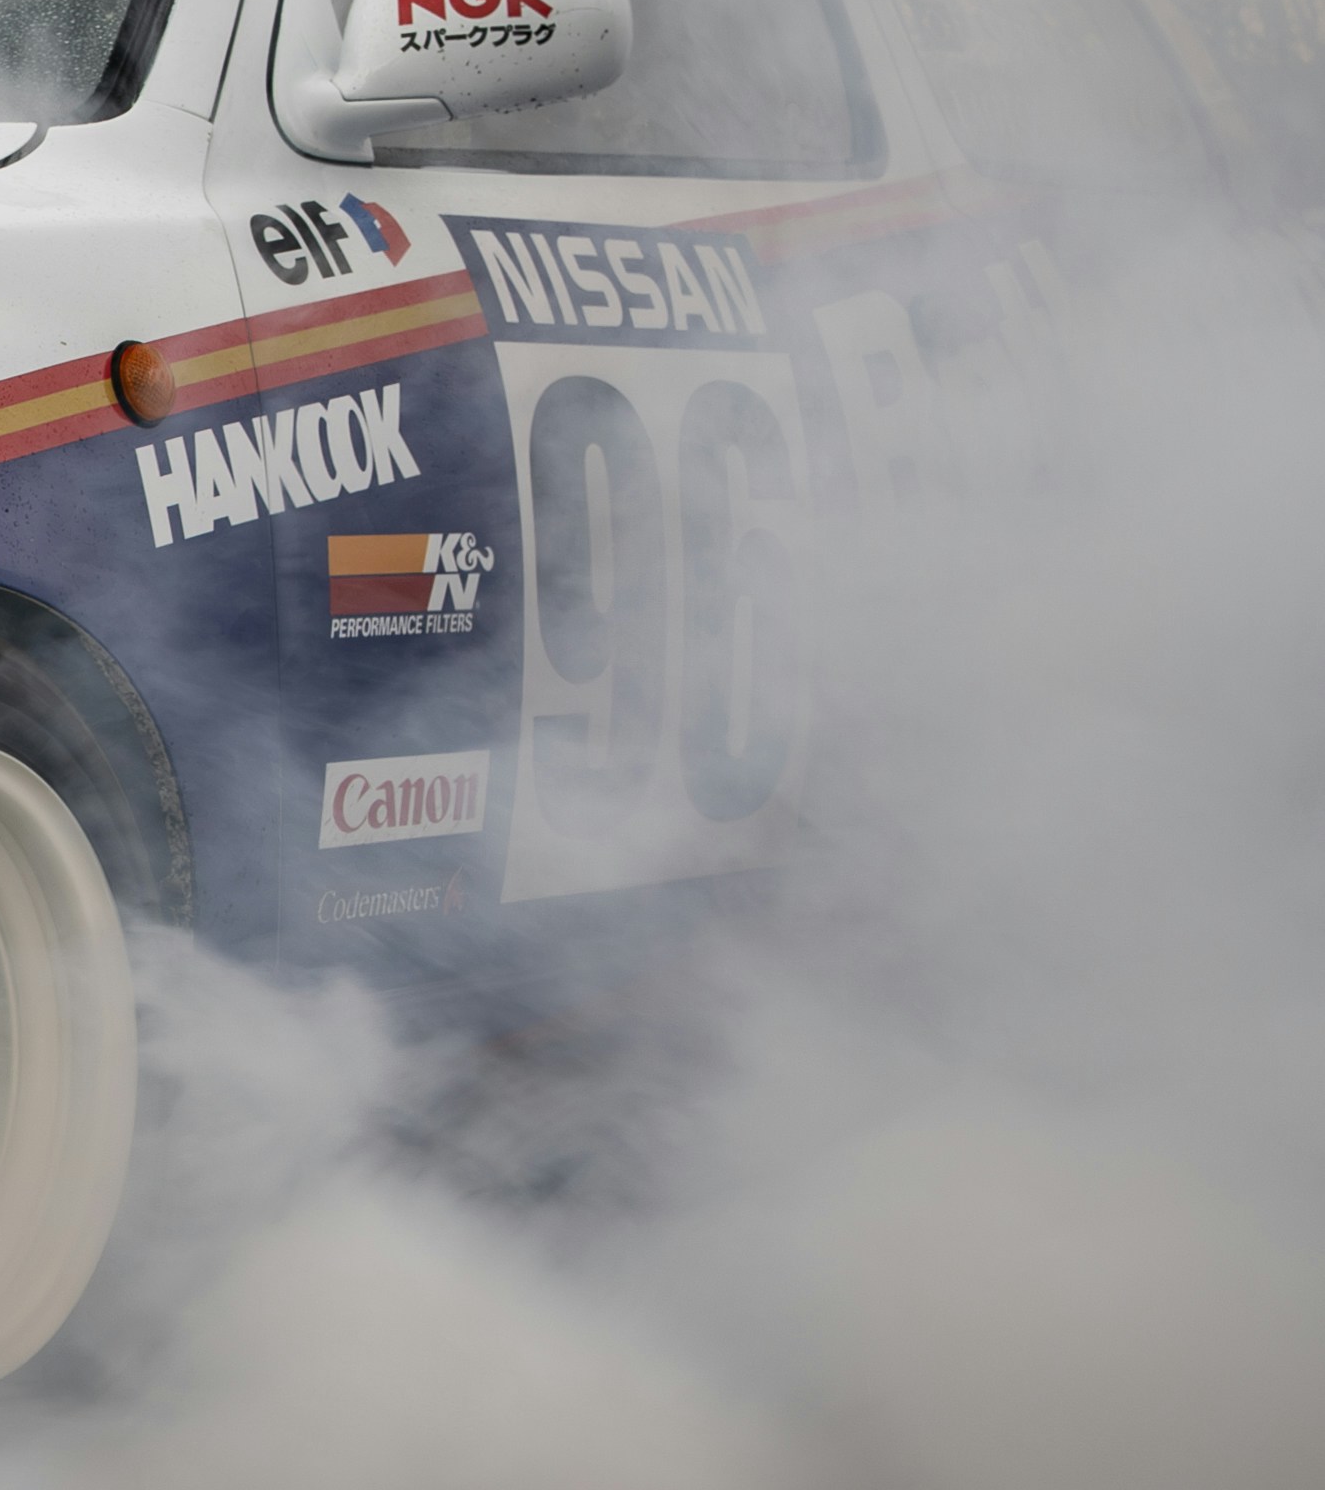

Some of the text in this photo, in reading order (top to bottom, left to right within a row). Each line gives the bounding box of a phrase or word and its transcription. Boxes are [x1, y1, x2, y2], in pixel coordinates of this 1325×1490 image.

[400, 23, 556, 53] スパークプラグ
[250, 200, 353, 285] elf
[470, 230, 766, 335] NISSAN
[136, 383, 421, 548] HANKOOK
[331, 613, 473, 639] PERFORMANCE FILTERS
[529, 375, 802, 836] 96
[333, 773, 479, 834] Canon
[318, 886, 441, 924] Codemasters
